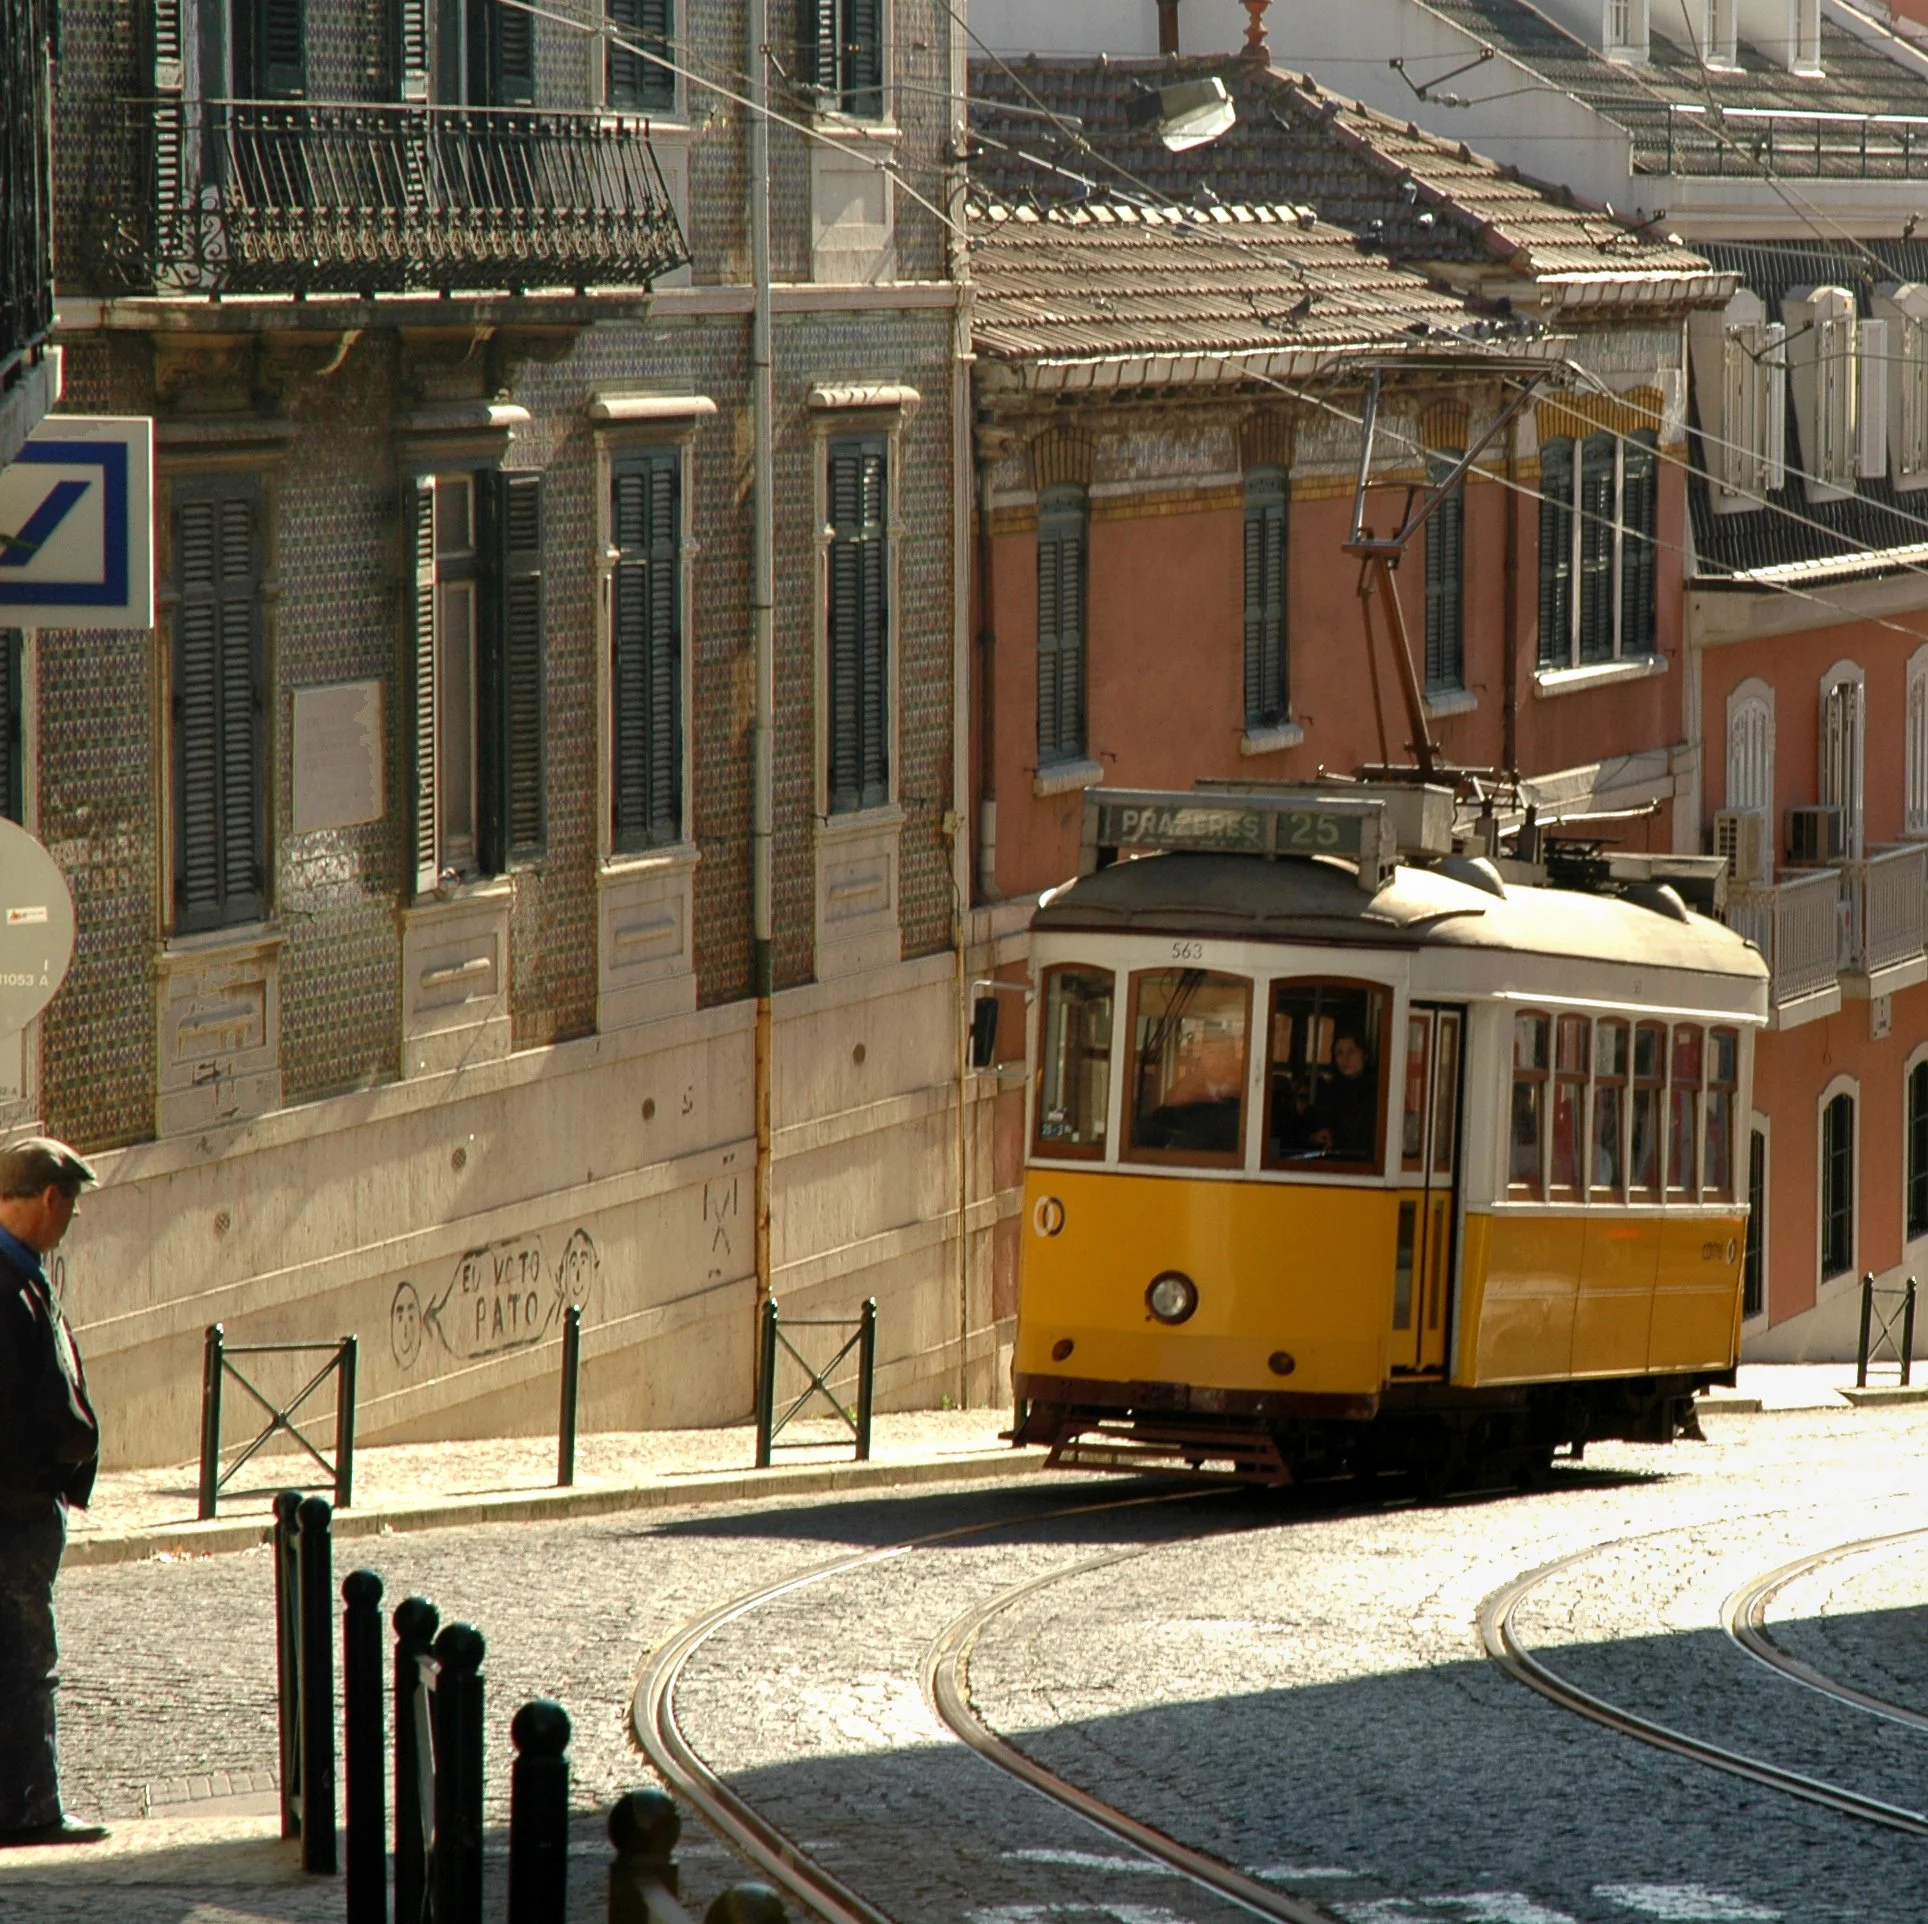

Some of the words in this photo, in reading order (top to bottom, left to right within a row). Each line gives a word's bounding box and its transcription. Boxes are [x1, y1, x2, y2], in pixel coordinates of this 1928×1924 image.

[1121, 808, 1259, 838] PRAZERES
[1289, 813, 1340, 845] 25
[1171, 941, 1203, 960] 563
[39, 974, 49, 987] A
[462, 1263, 481, 1293] EU
[475, 1291, 538, 1341] PATO
